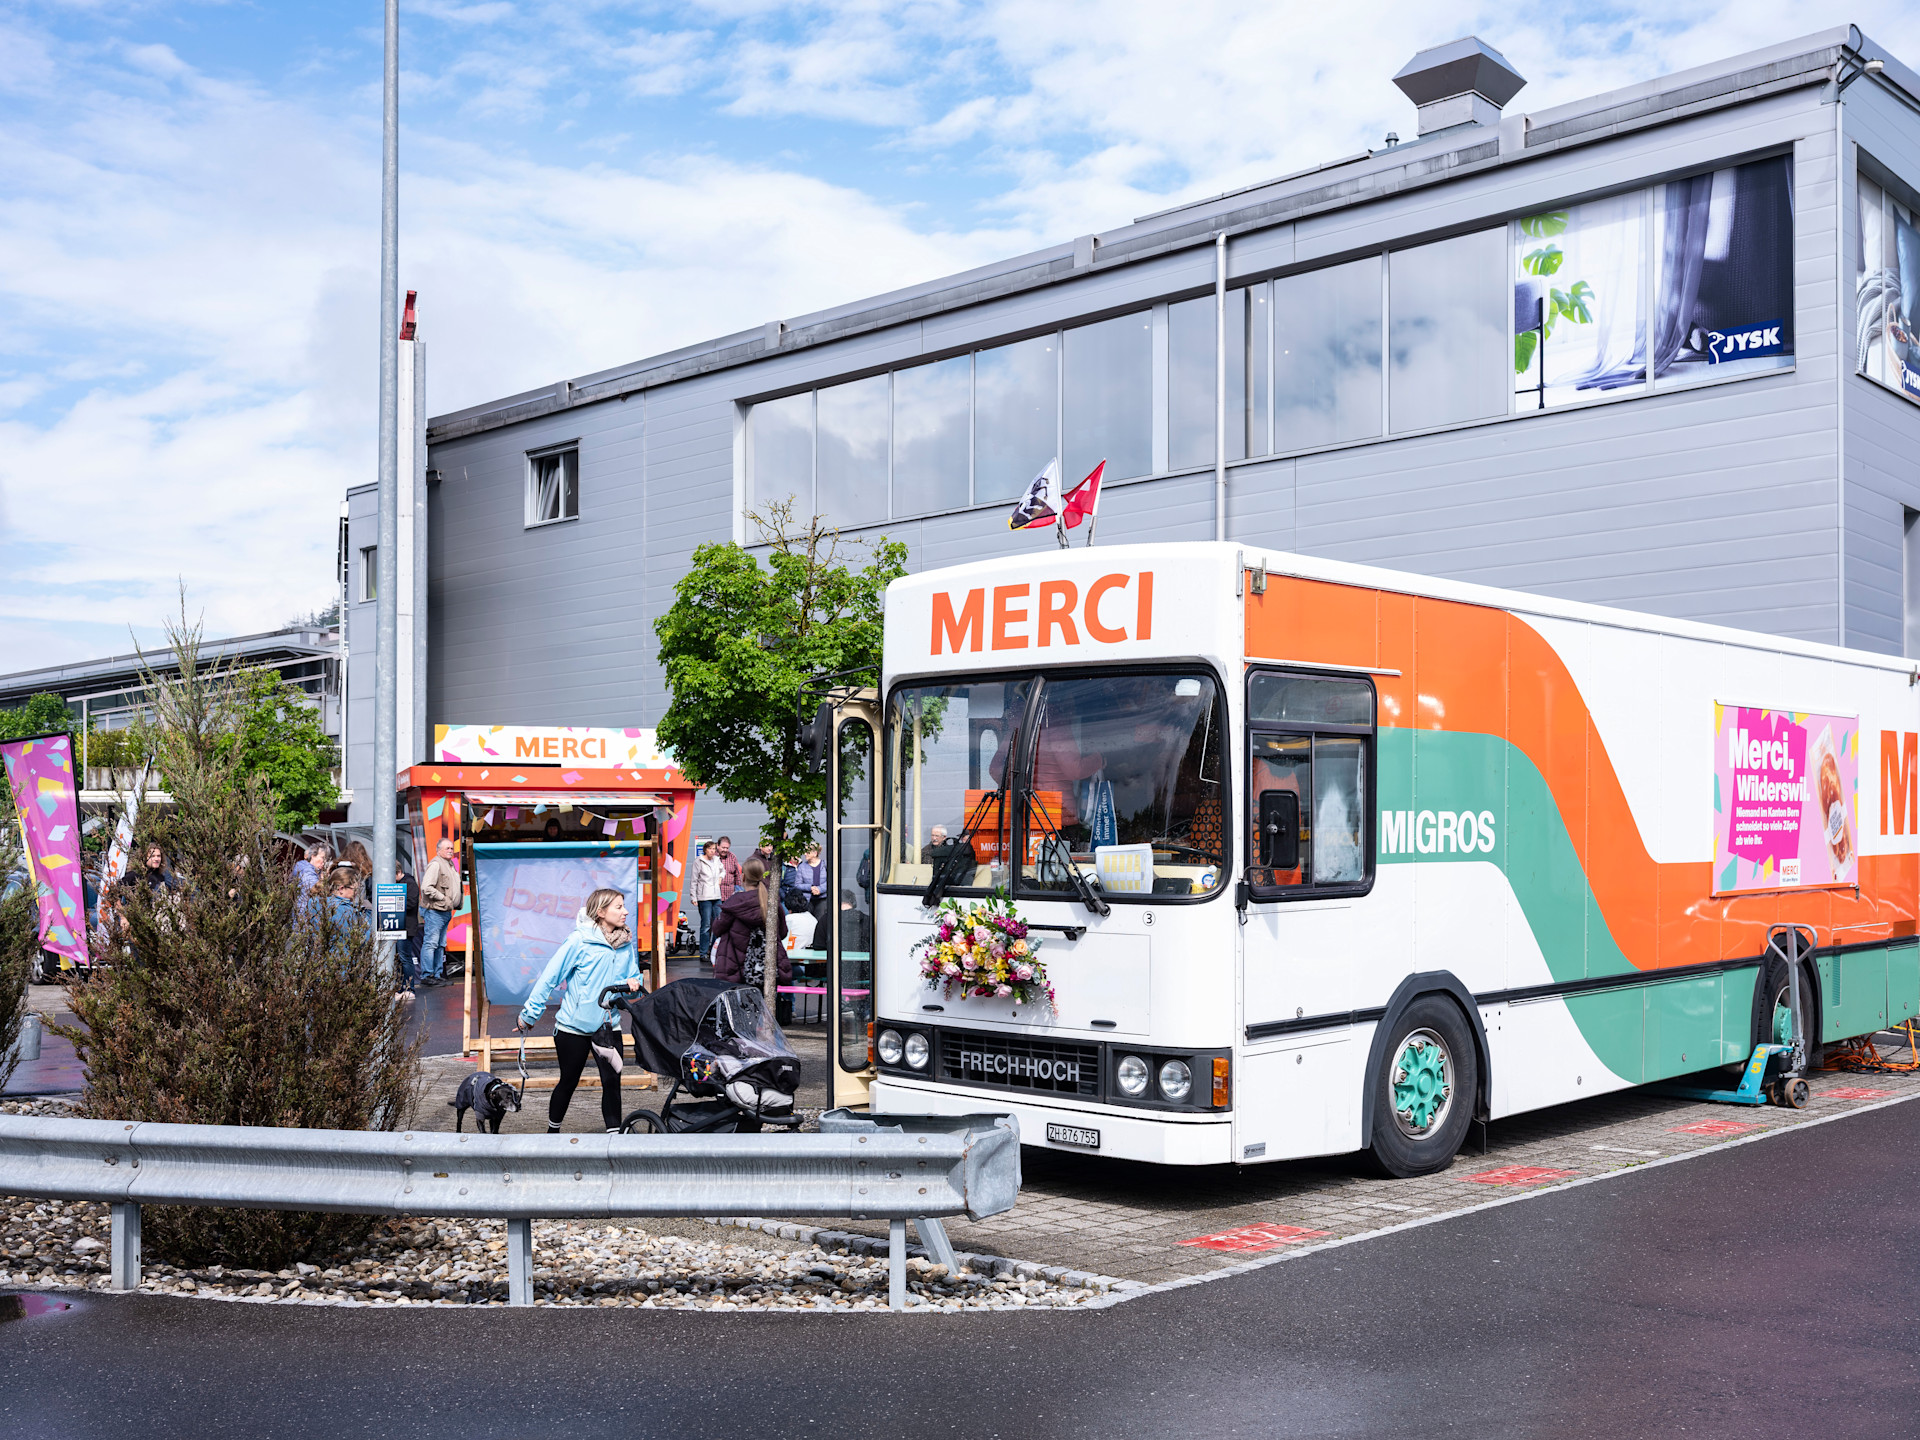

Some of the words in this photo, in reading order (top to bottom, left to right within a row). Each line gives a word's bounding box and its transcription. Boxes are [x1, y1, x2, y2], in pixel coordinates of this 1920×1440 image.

[1723, 327, 1780, 354] JYSK
[931, 571, 1154, 656] MERCI
[515, 736, 606, 759] MERCI
[1729, 728, 1794, 779] Merci,
[1737, 775, 1810, 802] Wilderswil.
[1736, 807, 1760, 817] Niemand
[1761, 807, 1767, 817] im
[1768, 807, 1786, 817] Kanton
[1787, 807, 1799, 817] Bern
[1102, 815, 1110, 840] immer
[1381, 810, 1496, 854] MIGROS
[1736, 821, 1762, 831] schneidet
[1763, 823, 1769, 831] so
[1770, 820, 1782, 831] viele
[1783, 820, 1798, 832] Zöpfe
[1736, 835, 1743, 845] ab
[1744, 835, 1753, 845] wie
[1754, 834, 1763, 845] ihr.
[1782, 865, 1799, 875] MERCI
[383, 918, 399, 929] 911
[960, 1051, 1080, 1083] FRECH-HOCH
